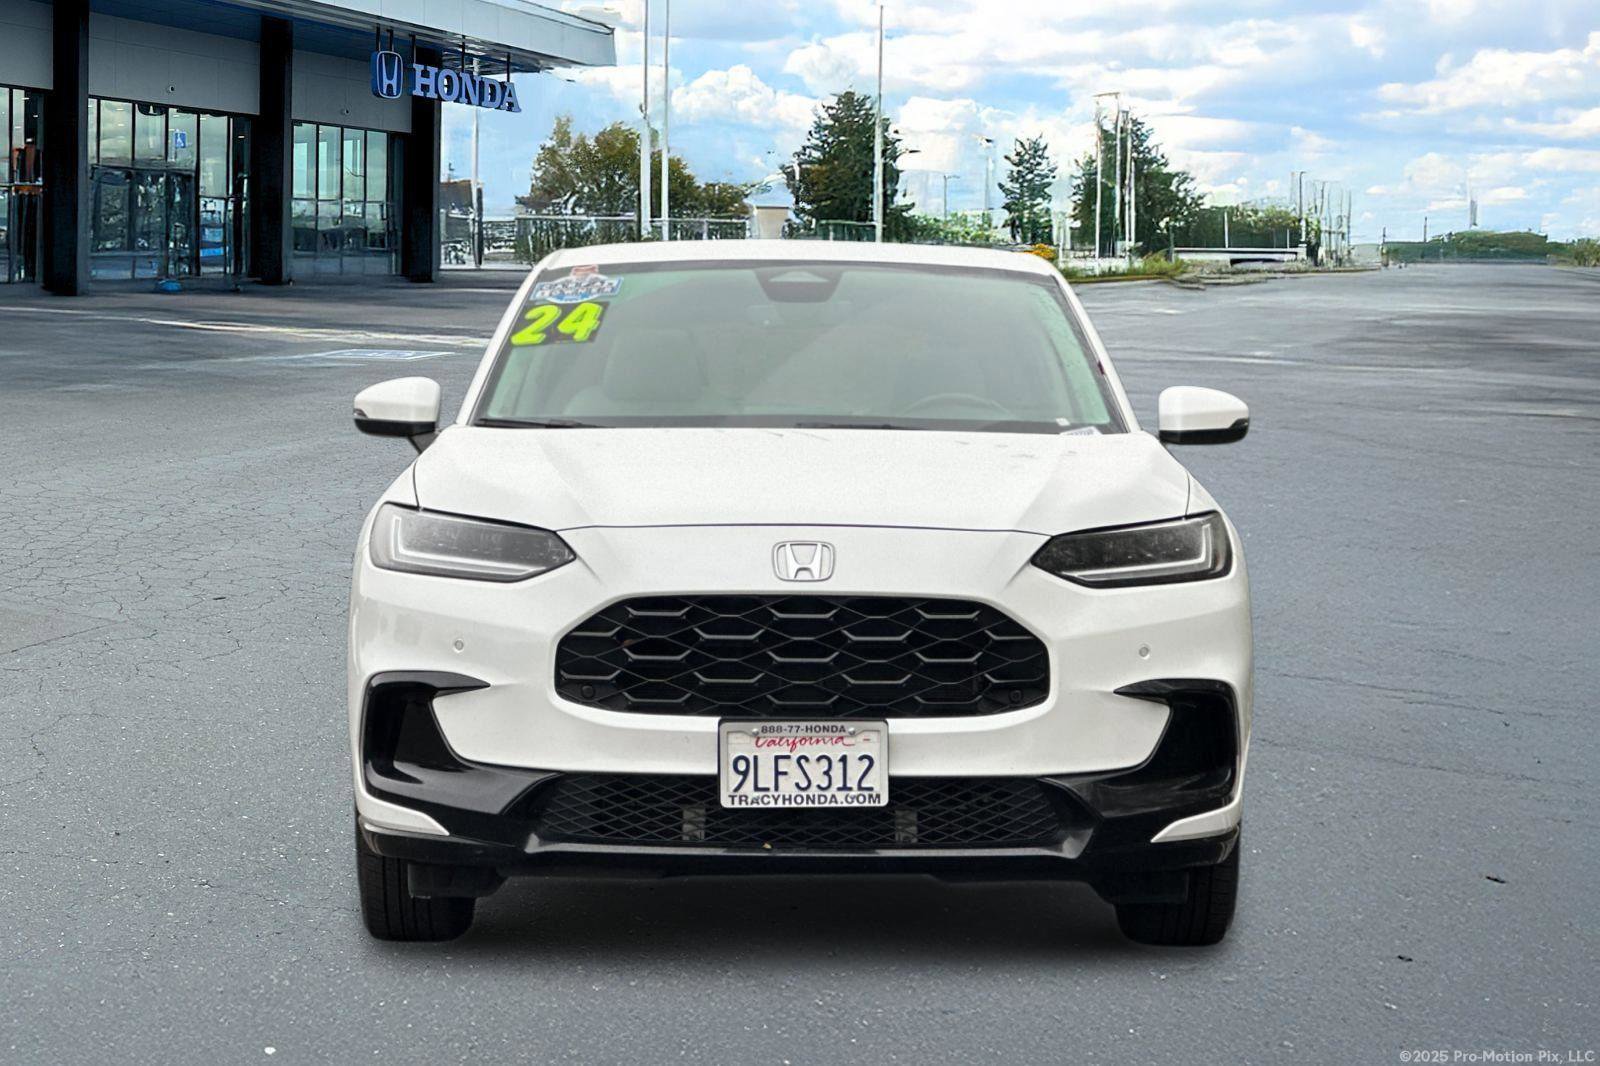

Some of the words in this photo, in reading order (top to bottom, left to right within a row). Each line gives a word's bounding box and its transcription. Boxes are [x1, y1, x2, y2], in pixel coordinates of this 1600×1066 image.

[411, 63, 521, 112] HONDA
[511, 302, 602, 345] 24
[761, 725, 846, 734] 888-77-HONDA
[732, 754, 875, 792] 9LFS312
[728, 793, 881, 806] TRACYHONDA.COM
